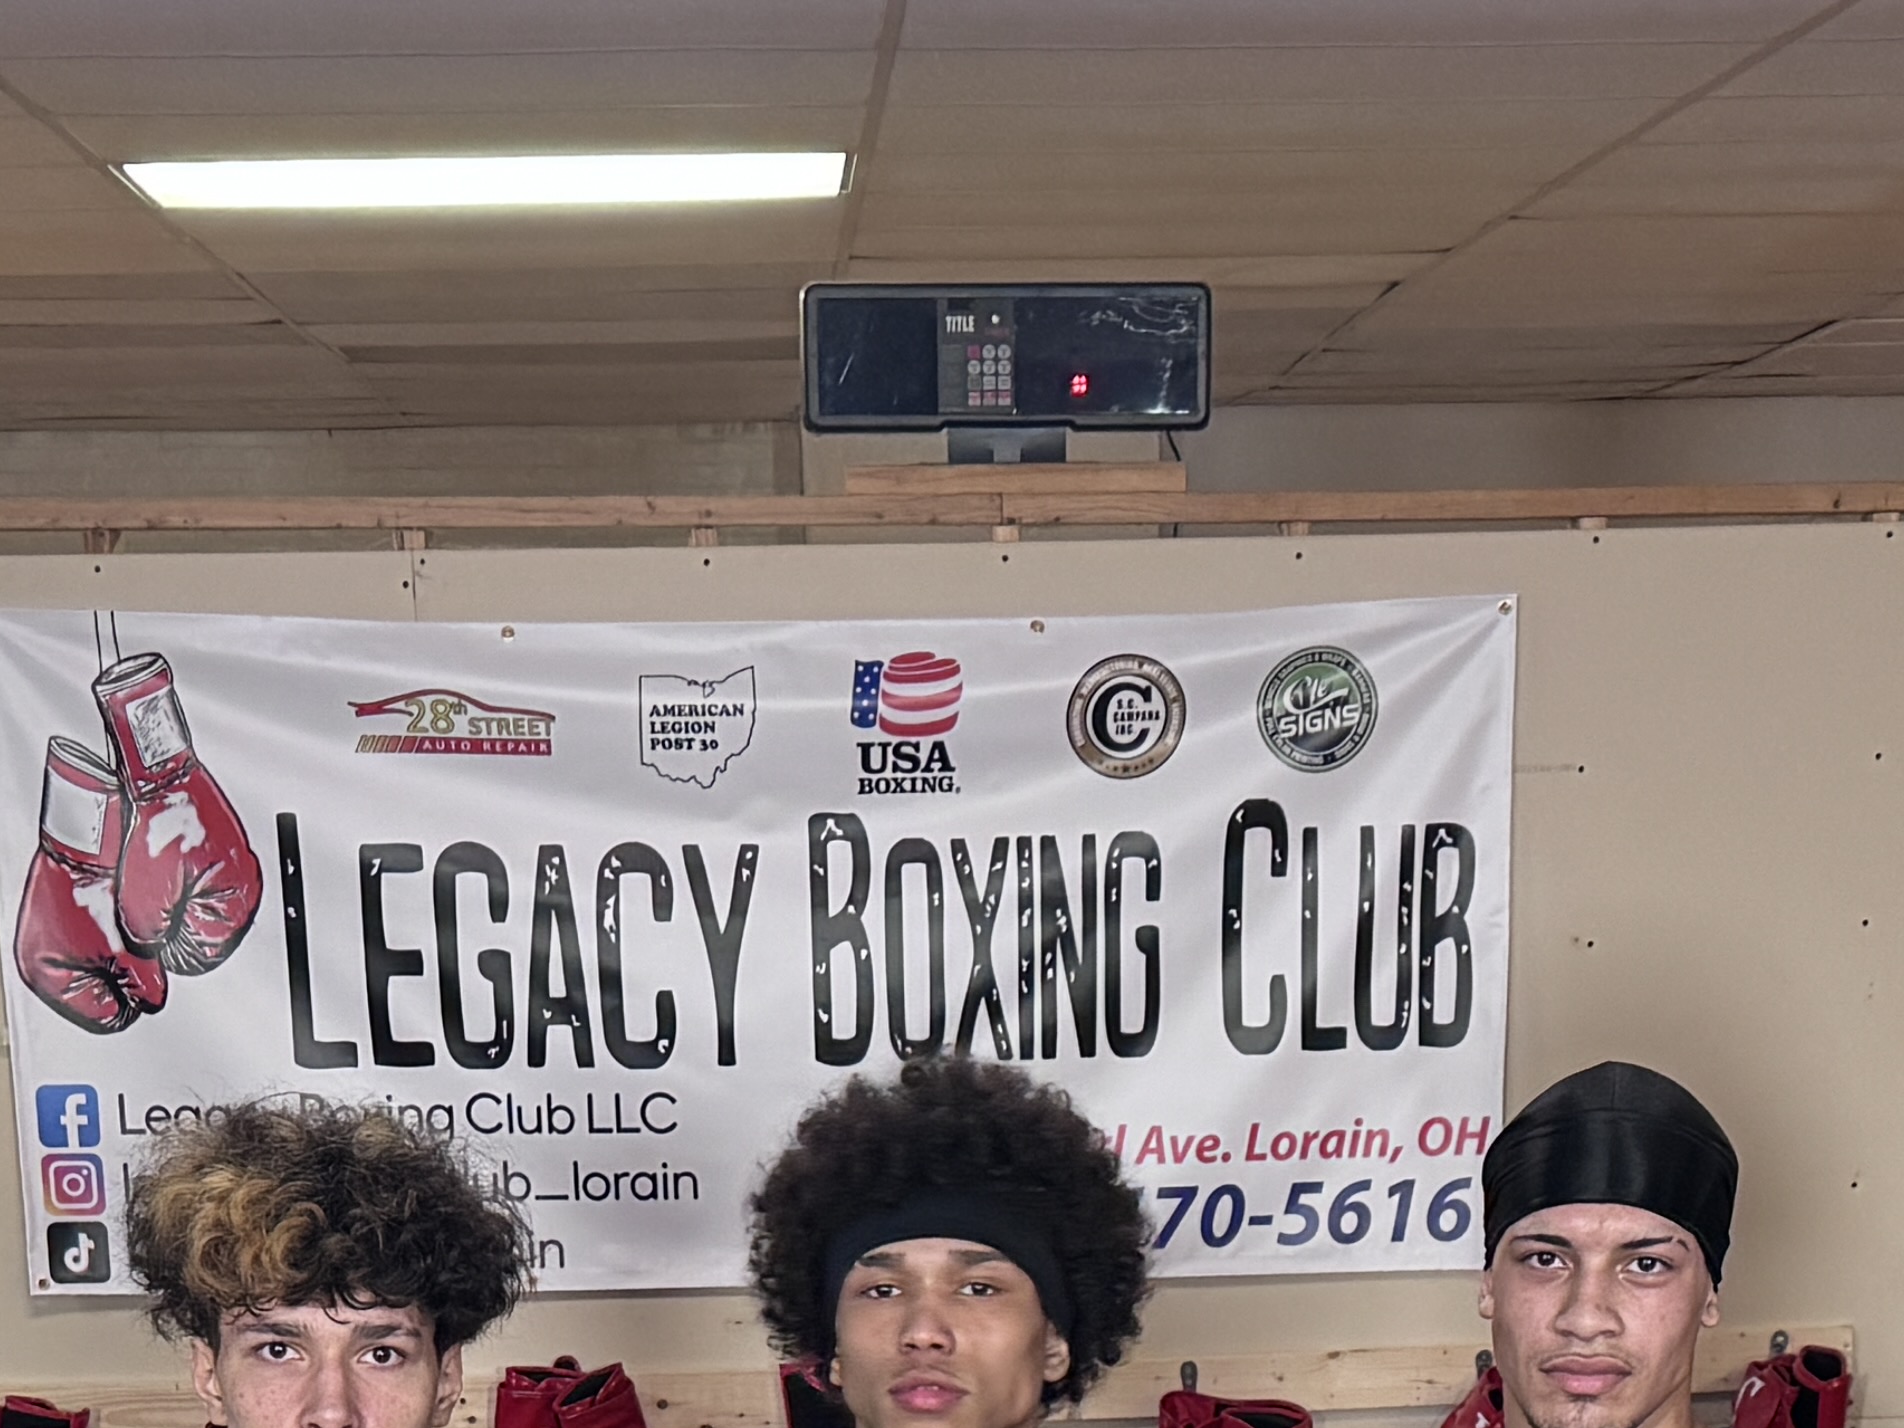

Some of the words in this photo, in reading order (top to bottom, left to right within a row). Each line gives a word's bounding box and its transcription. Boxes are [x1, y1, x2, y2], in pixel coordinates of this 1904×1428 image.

[945, 315, 975, 333] TITLE
[649, 704, 745, 717] AMERICAN
[1278, 703, 1361, 738] SIGNS
[468, 716, 555, 737] STREET
[650, 721, 716, 735] LEGION
[422, 740, 471, 751] AUTO
[483, 740, 549, 753] REPAIR
[651, 737, 696, 751] POST
[700, 740, 719, 751] 30
[857, 741, 955, 775] USA
[276, 812, 760, 1070] LEGACY
[807, 812, 1163, 1067] BOXING
[1221, 798, 1477, 1056] CLUB
[465, 1092, 576, 1135] Club
[587, 1092, 679, 1135] LLC
[1136, 1118, 1232, 1166] Ave.
[1245, 1116, 1404, 1166] Lorain,
[1417, 1115, 1493, 1159] OH
[1152, 1176, 1474, 1249] 70-5616
